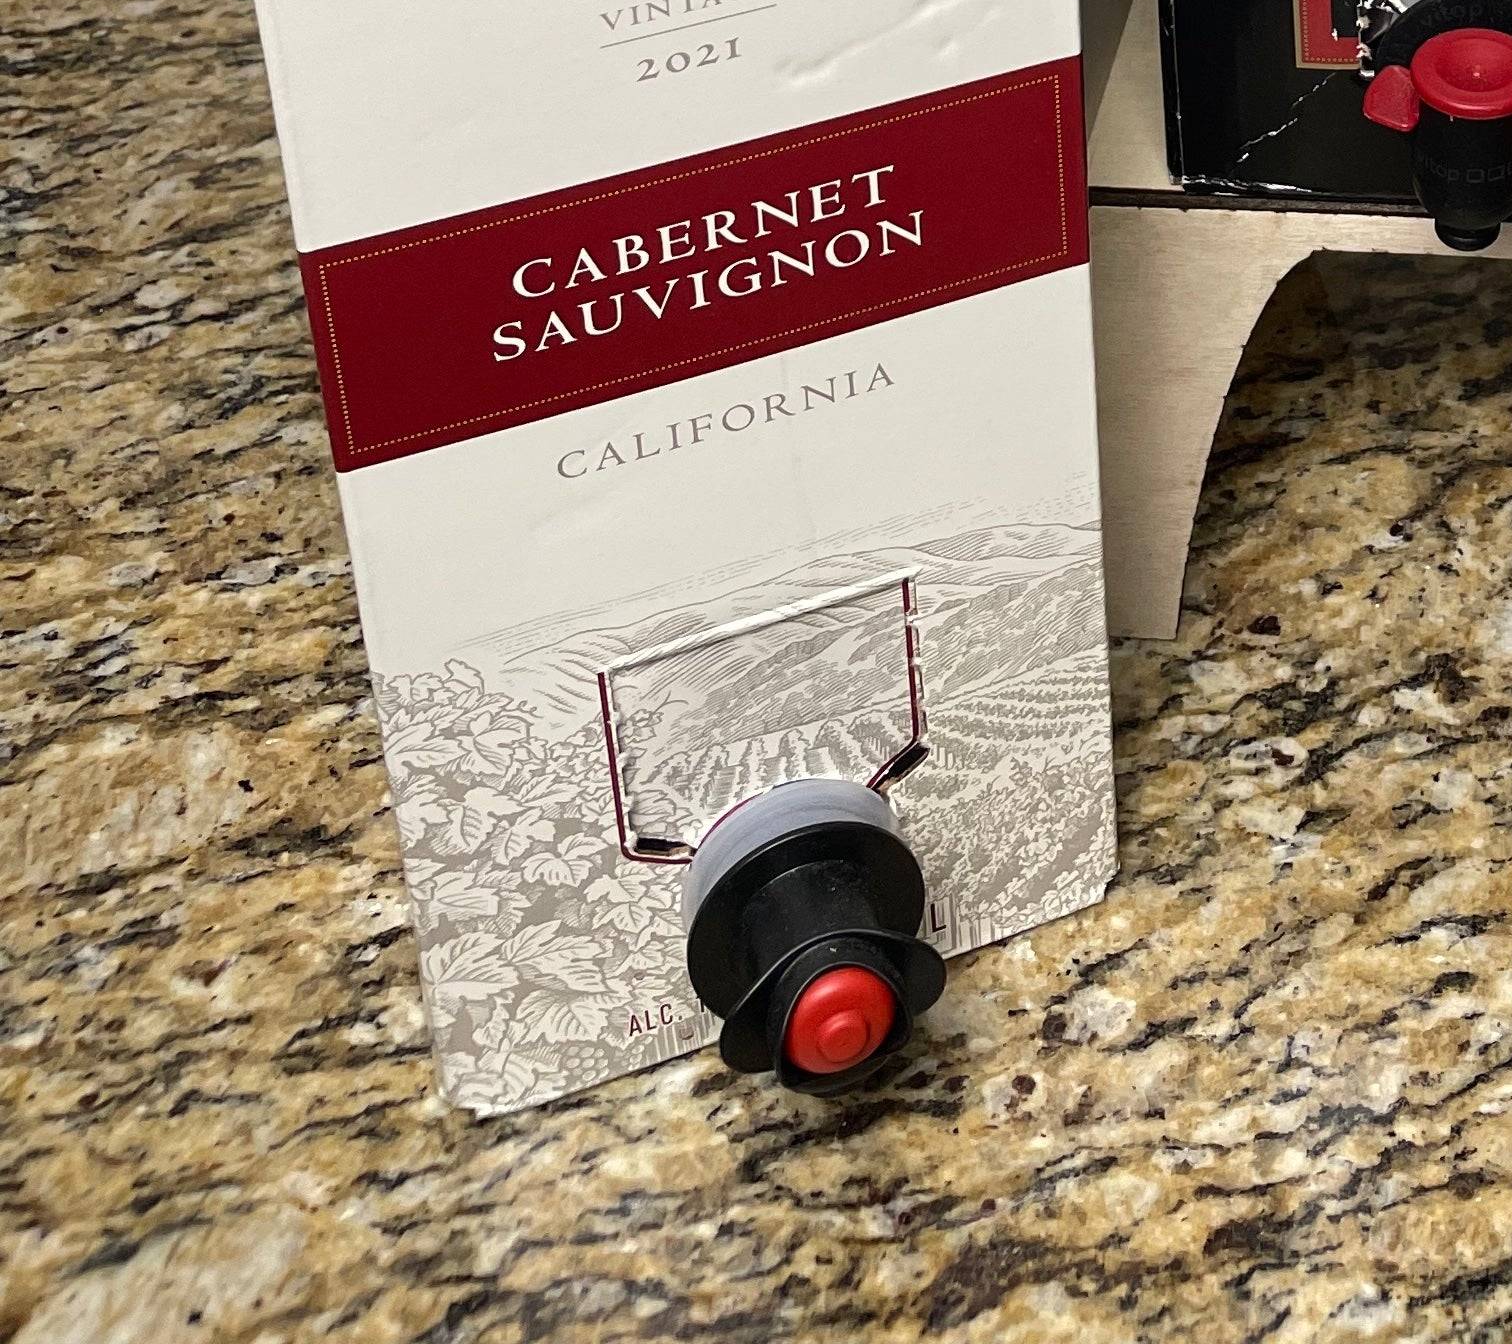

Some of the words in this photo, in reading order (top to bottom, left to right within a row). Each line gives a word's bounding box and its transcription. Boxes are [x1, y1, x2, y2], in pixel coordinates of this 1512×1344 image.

[636, 37, 743, 82] 2021
[493, 210, 924, 362] SAUVIGNON
[512, 165, 894, 299] CABERNET
[557, 363, 895, 479] CALIFORNIA
[629, 1003, 683, 1037] ALC.
